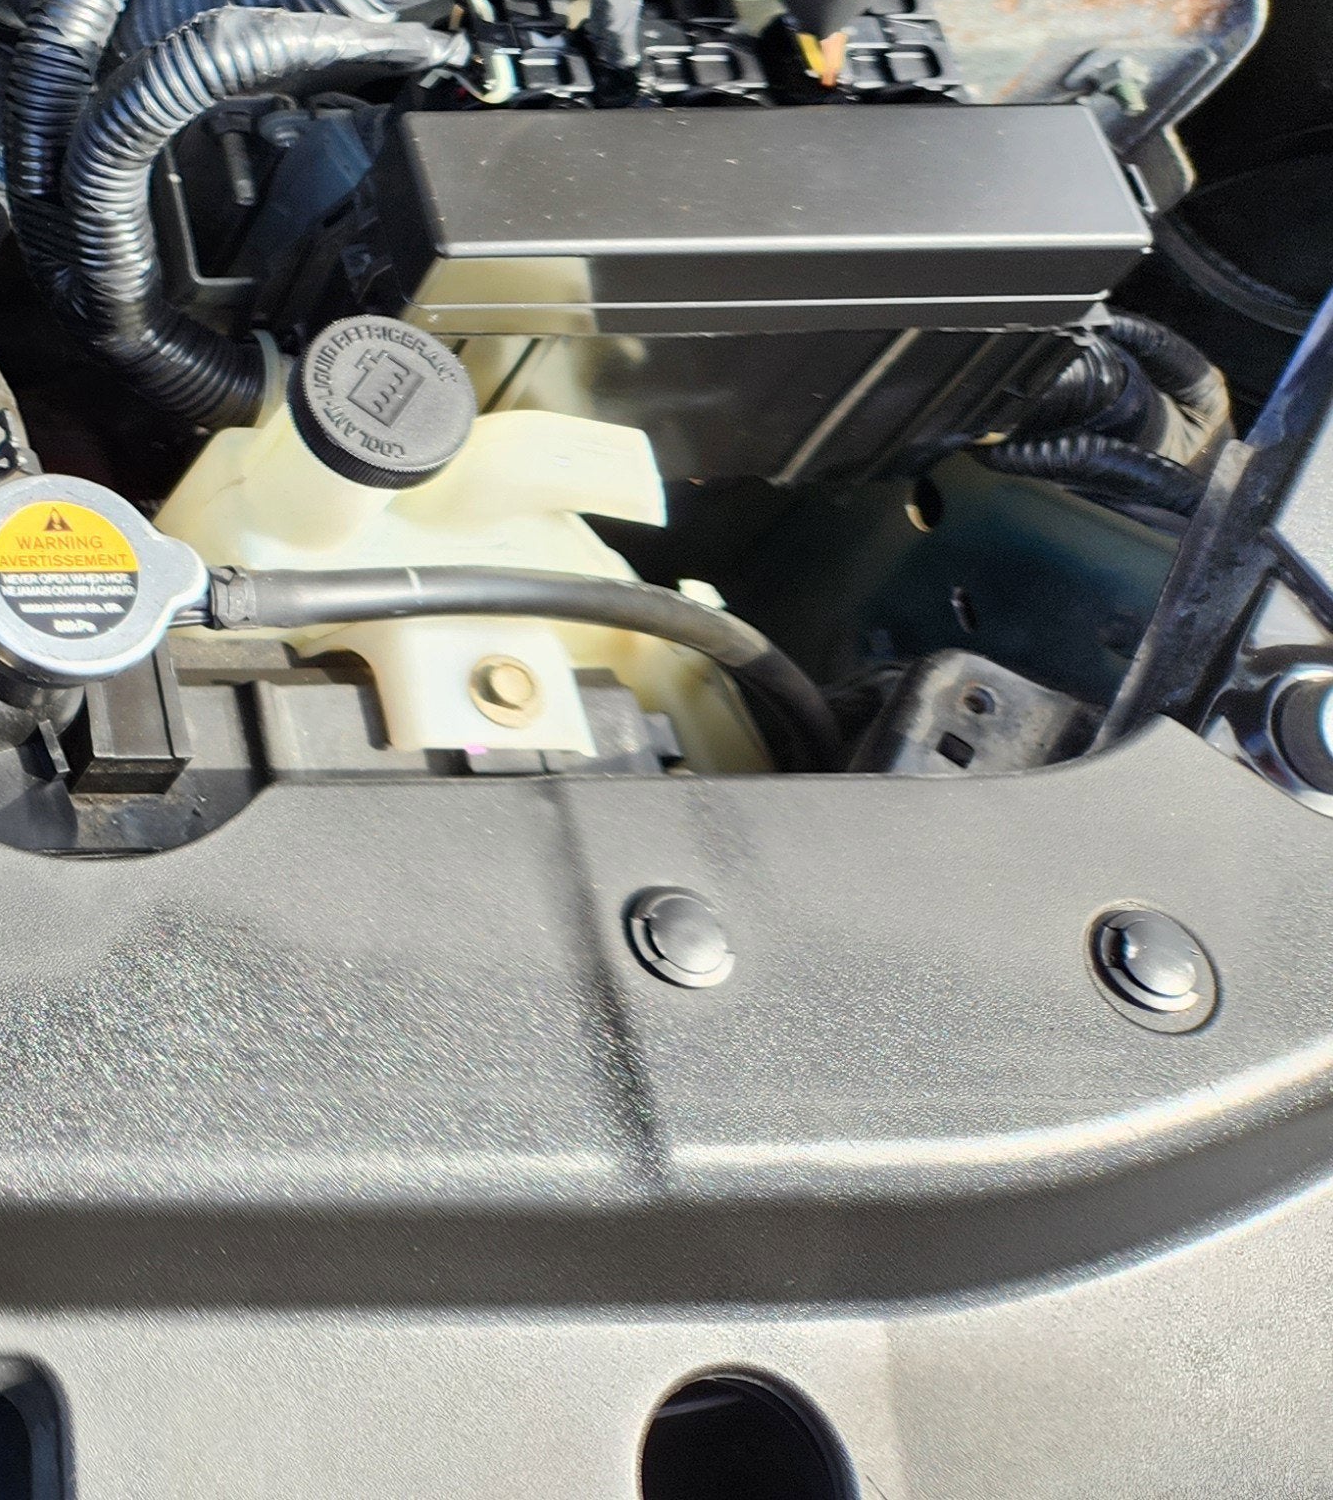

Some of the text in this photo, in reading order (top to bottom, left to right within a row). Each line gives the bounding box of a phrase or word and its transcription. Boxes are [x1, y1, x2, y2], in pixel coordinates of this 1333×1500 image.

[332, 326, 457, 382] REFRIGERANT
[15, 535, 103, 550] WARNING
[0, 553, 128, 567] AVERTISSEMENT
[2, 573, 36, 585] NEVER
[38, 573, 68, 585] OPEN
[70, 573, 104, 584] WHEN
[17, 585, 51, 596] JAMAIS
